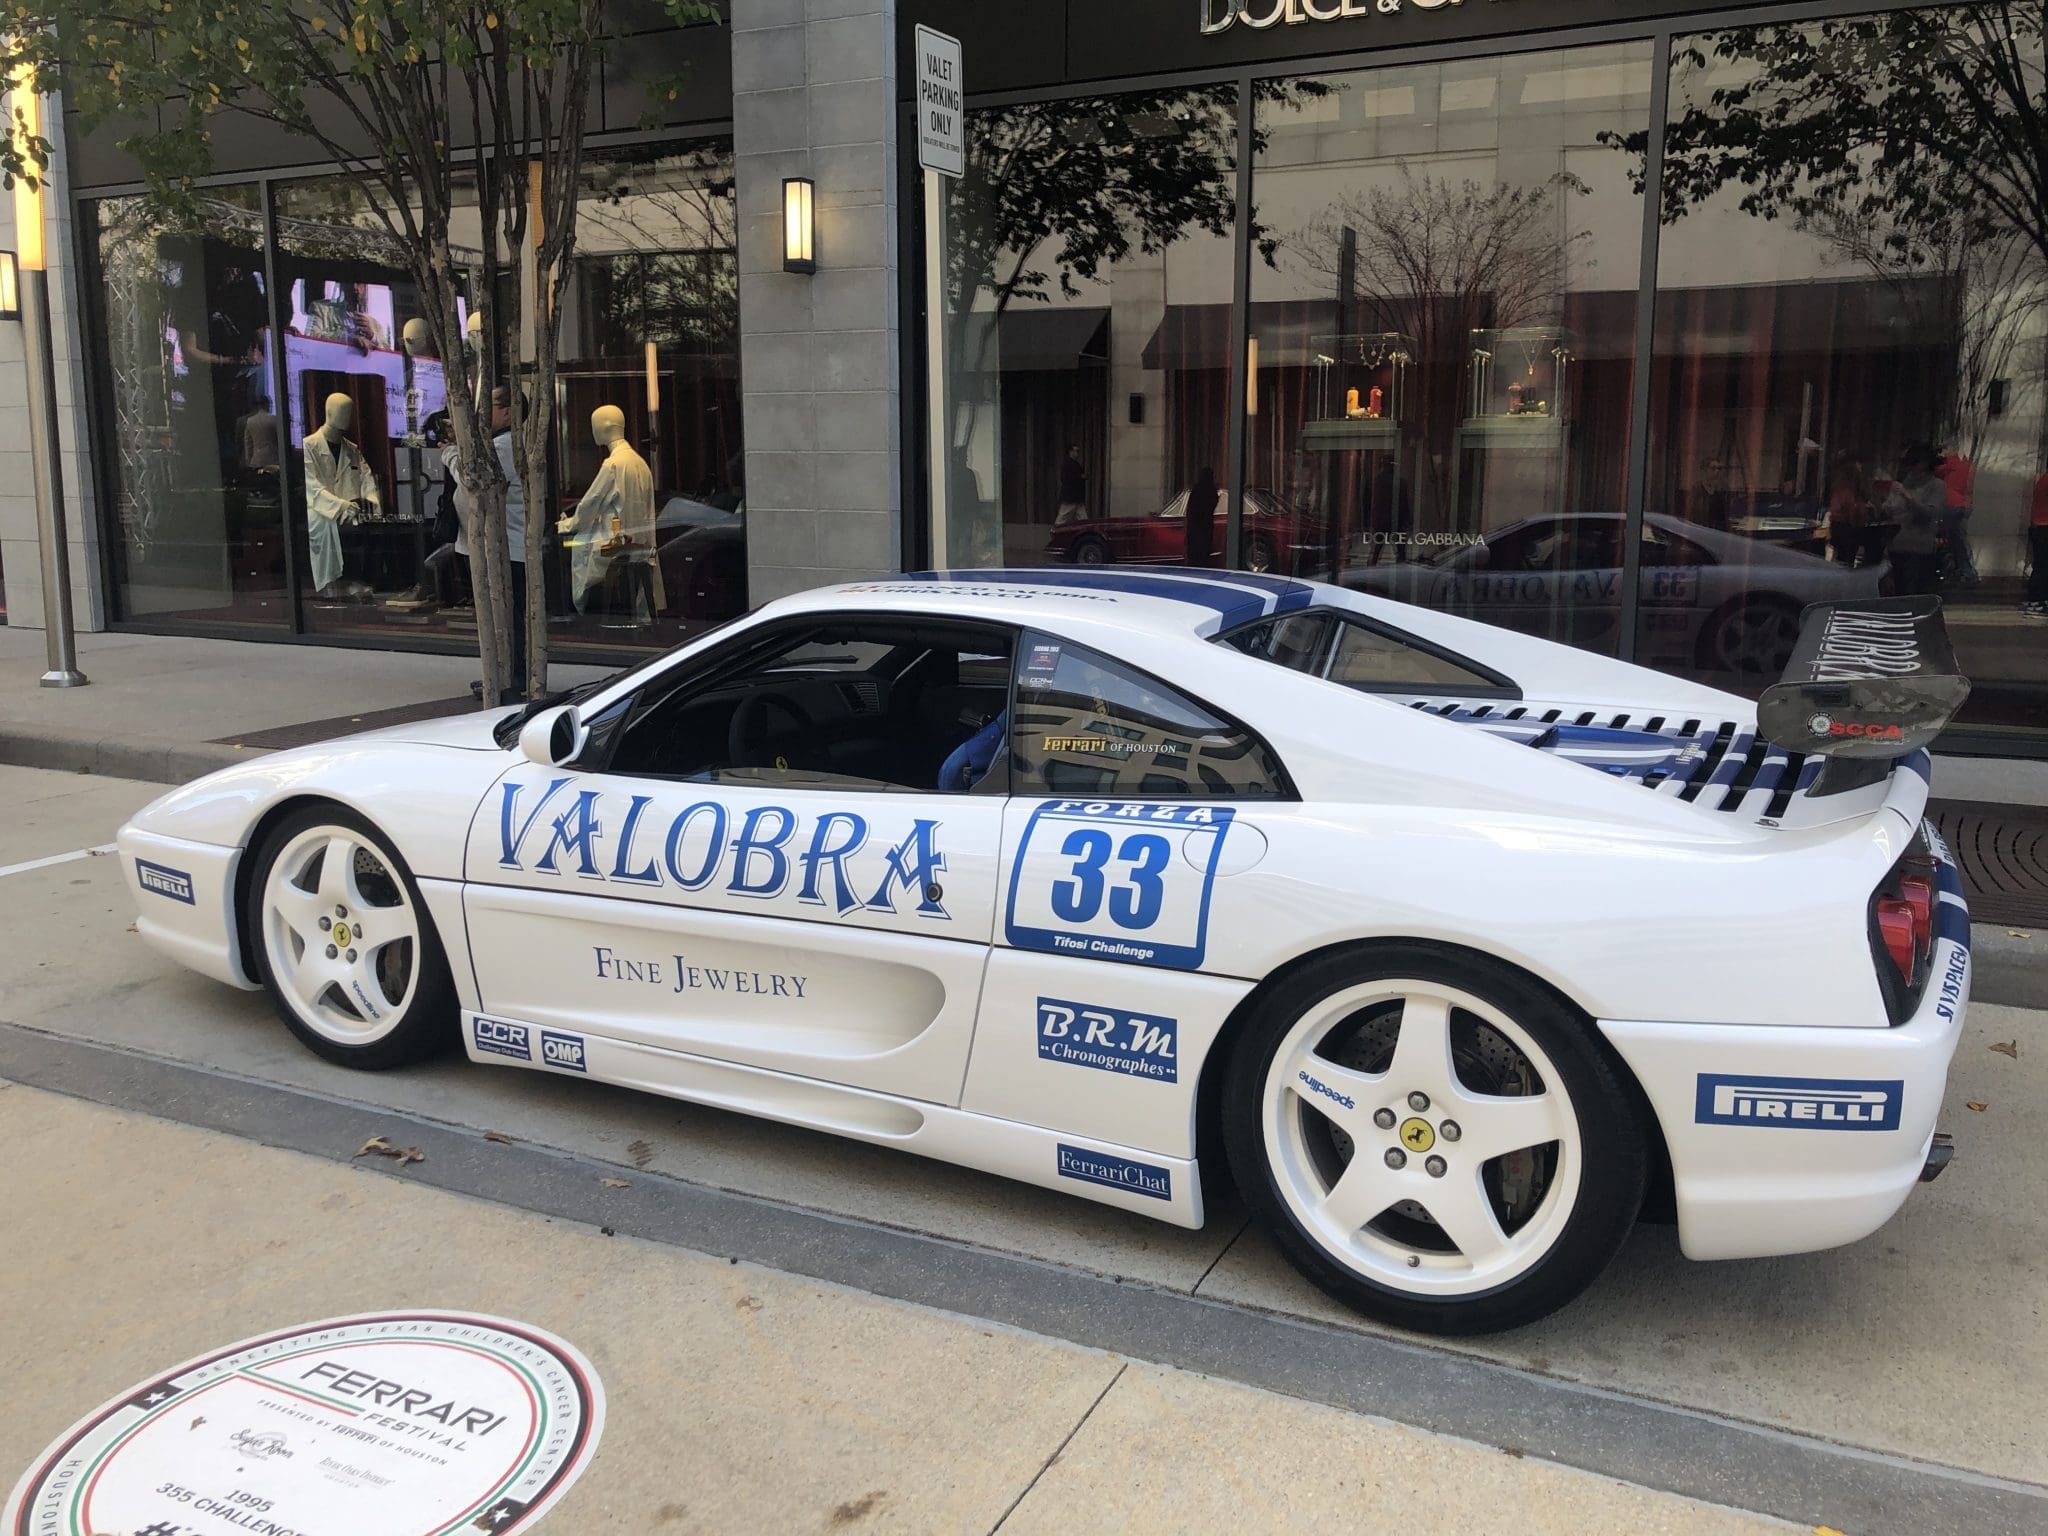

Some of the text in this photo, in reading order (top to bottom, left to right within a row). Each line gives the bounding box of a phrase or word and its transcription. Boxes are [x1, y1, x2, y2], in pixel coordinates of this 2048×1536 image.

[926, 53, 952, 82] VALET
[922, 80, 959, 111] PARKING
[930, 111, 952, 136] ONLY
[1363, 532, 1407, 544] DOLCE
[1414, 532, 1486, 546] GABBANA
[1042, 736, 1177, 753] Ferrari OF HOUSTON
[1830, 722, 1903, 740] SCCA
[1052, 800, 1214, 823] FORZA
[498, 777, 953, 920] VALOBRA
[140, 865, 190, 898] PIRELLI
[1051, 829, 1171, 930] 33
[1053, 935, 1154, 960] Tifosi Challenge
[352, 979, 381, 1020] speedline
[477, 1019, 526, 1045] CCR
[543, 1041, 582, 1062] OMP
[1051, 1042, 1165, 1076] Chronographes
[1298, 1070, 1355, 1110] speedline
[1713, 1085, 1888, 1122] PIRELLI
[1060, 1150, 1169, 1192] FerrariChat
[197, 1325, 572, 1486] BENEFITING TEXAS CHILDREN'S CANCER CENTER
[299, 1361, 508, 1437] FERRARI
[256, 1399, 314, 1422] PRESENTED
[379, 1440, 395, 1448] OF
[396, 1446, 449, 1466] HOUSTON
[364, 1412, 467, 1451] FESTIVAL
[155, 1482, 197, 1503] 355
[223, 1489, 276, 1512] 1995
